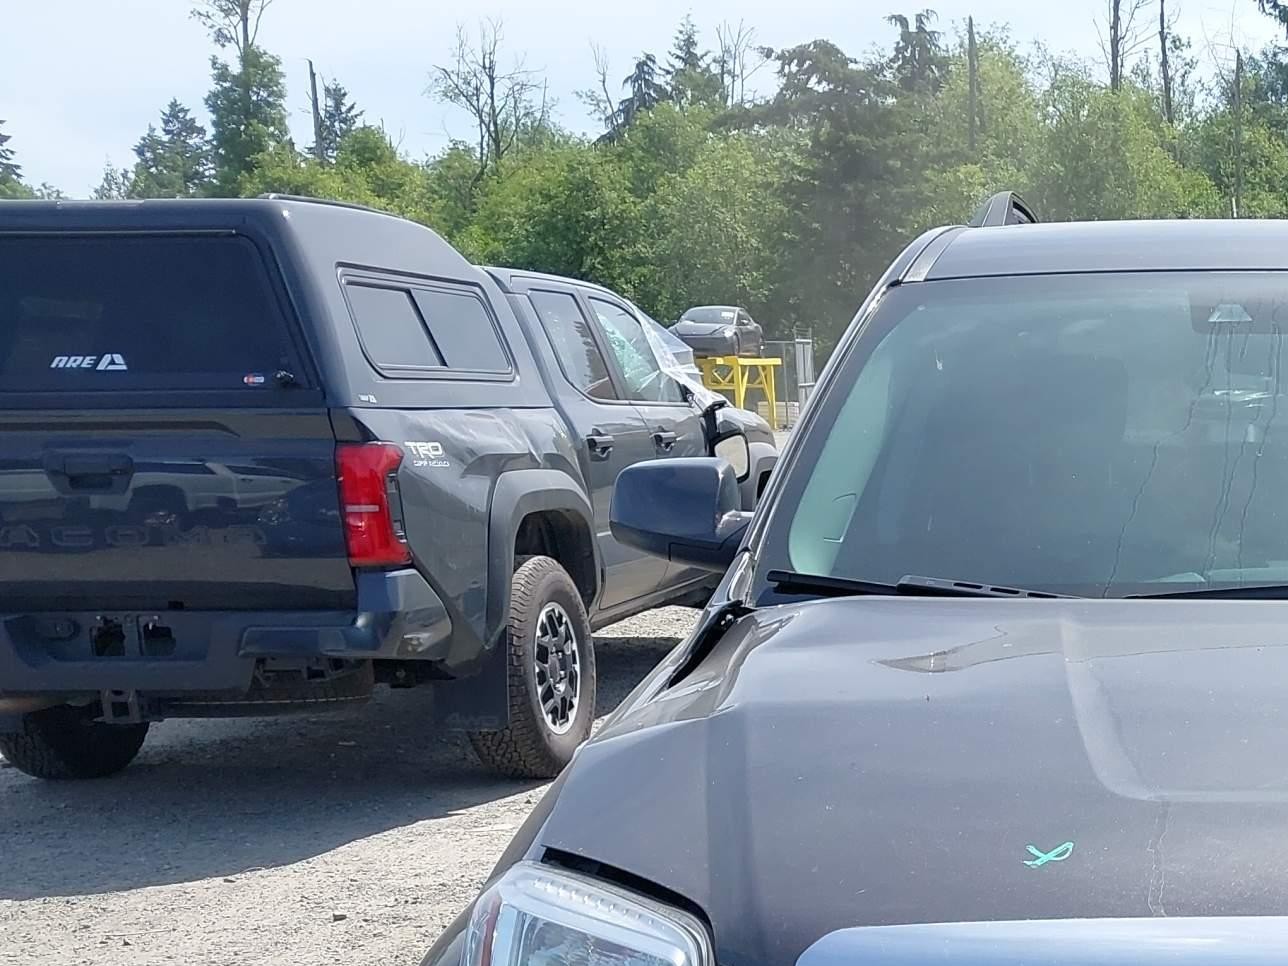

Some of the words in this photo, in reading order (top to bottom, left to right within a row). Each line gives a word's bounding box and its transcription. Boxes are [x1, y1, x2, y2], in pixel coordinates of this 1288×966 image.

[49, 355, 97, 368] ARE
[404, 441, 443, 459] TRD
[0, 523, 267, 547] ACOMA
